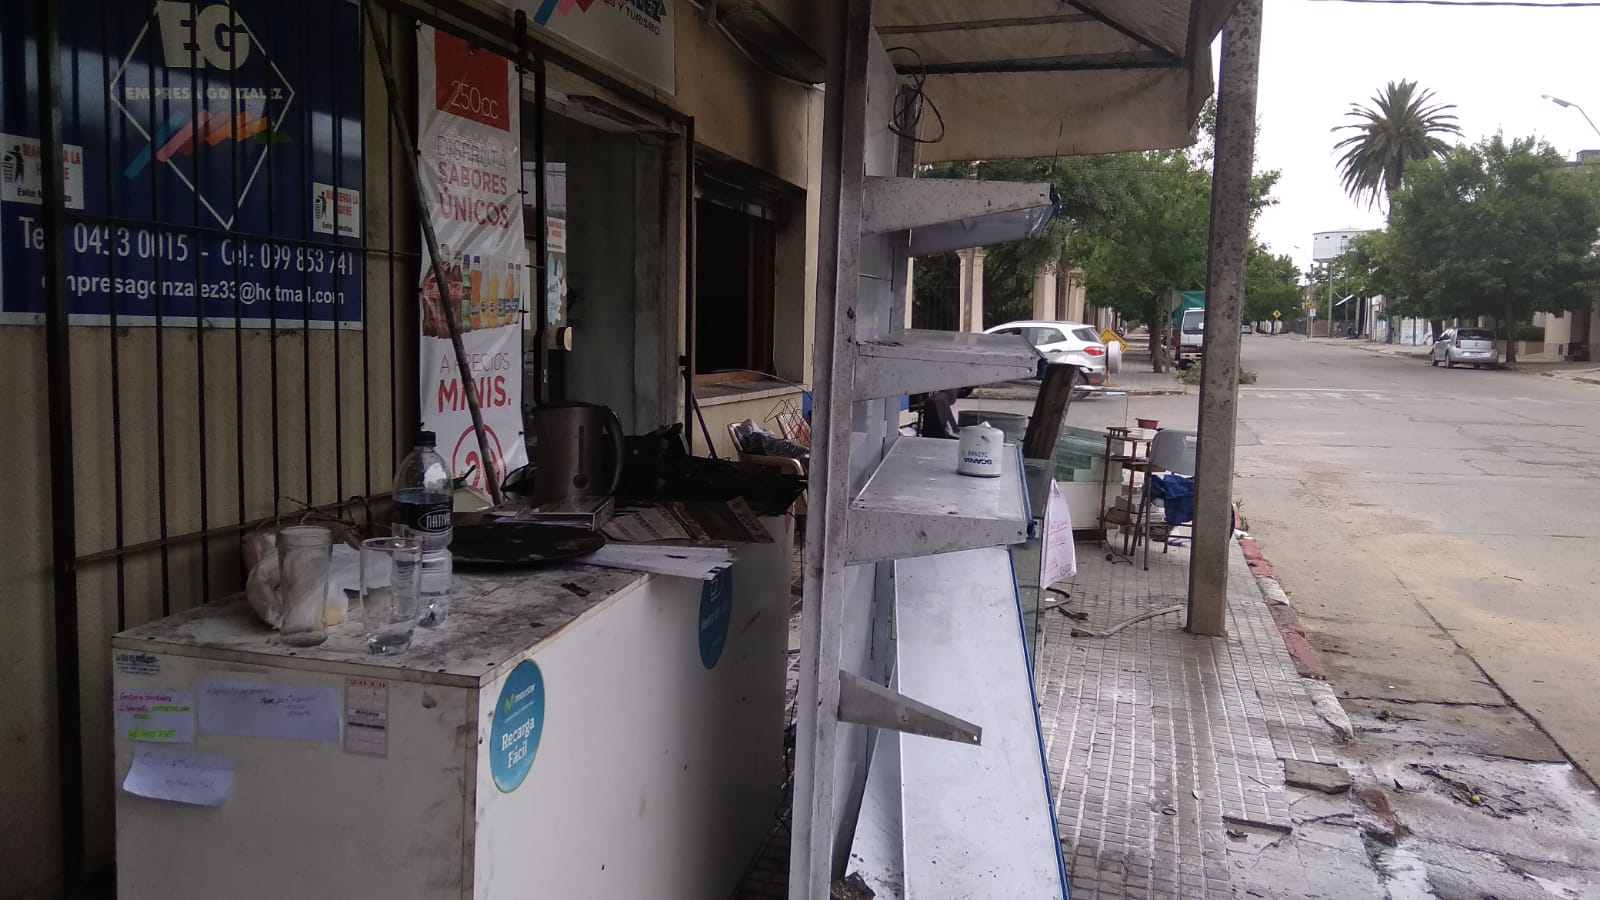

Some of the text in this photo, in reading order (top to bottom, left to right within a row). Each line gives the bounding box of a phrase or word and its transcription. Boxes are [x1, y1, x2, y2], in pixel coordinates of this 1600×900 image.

[155, 1, 250, 71] EG
[625, 6, 660, 36] TURISMO
[451, 80, 498, 119] 250cc
[438, 161, 507, 195] SABORES
[439, 187, 509, 229] ÚNICOS
[440, 354, 450, 374] A
[502, 717, 535, 751] Recarga
[507, 739, 528, 769] Fácil
